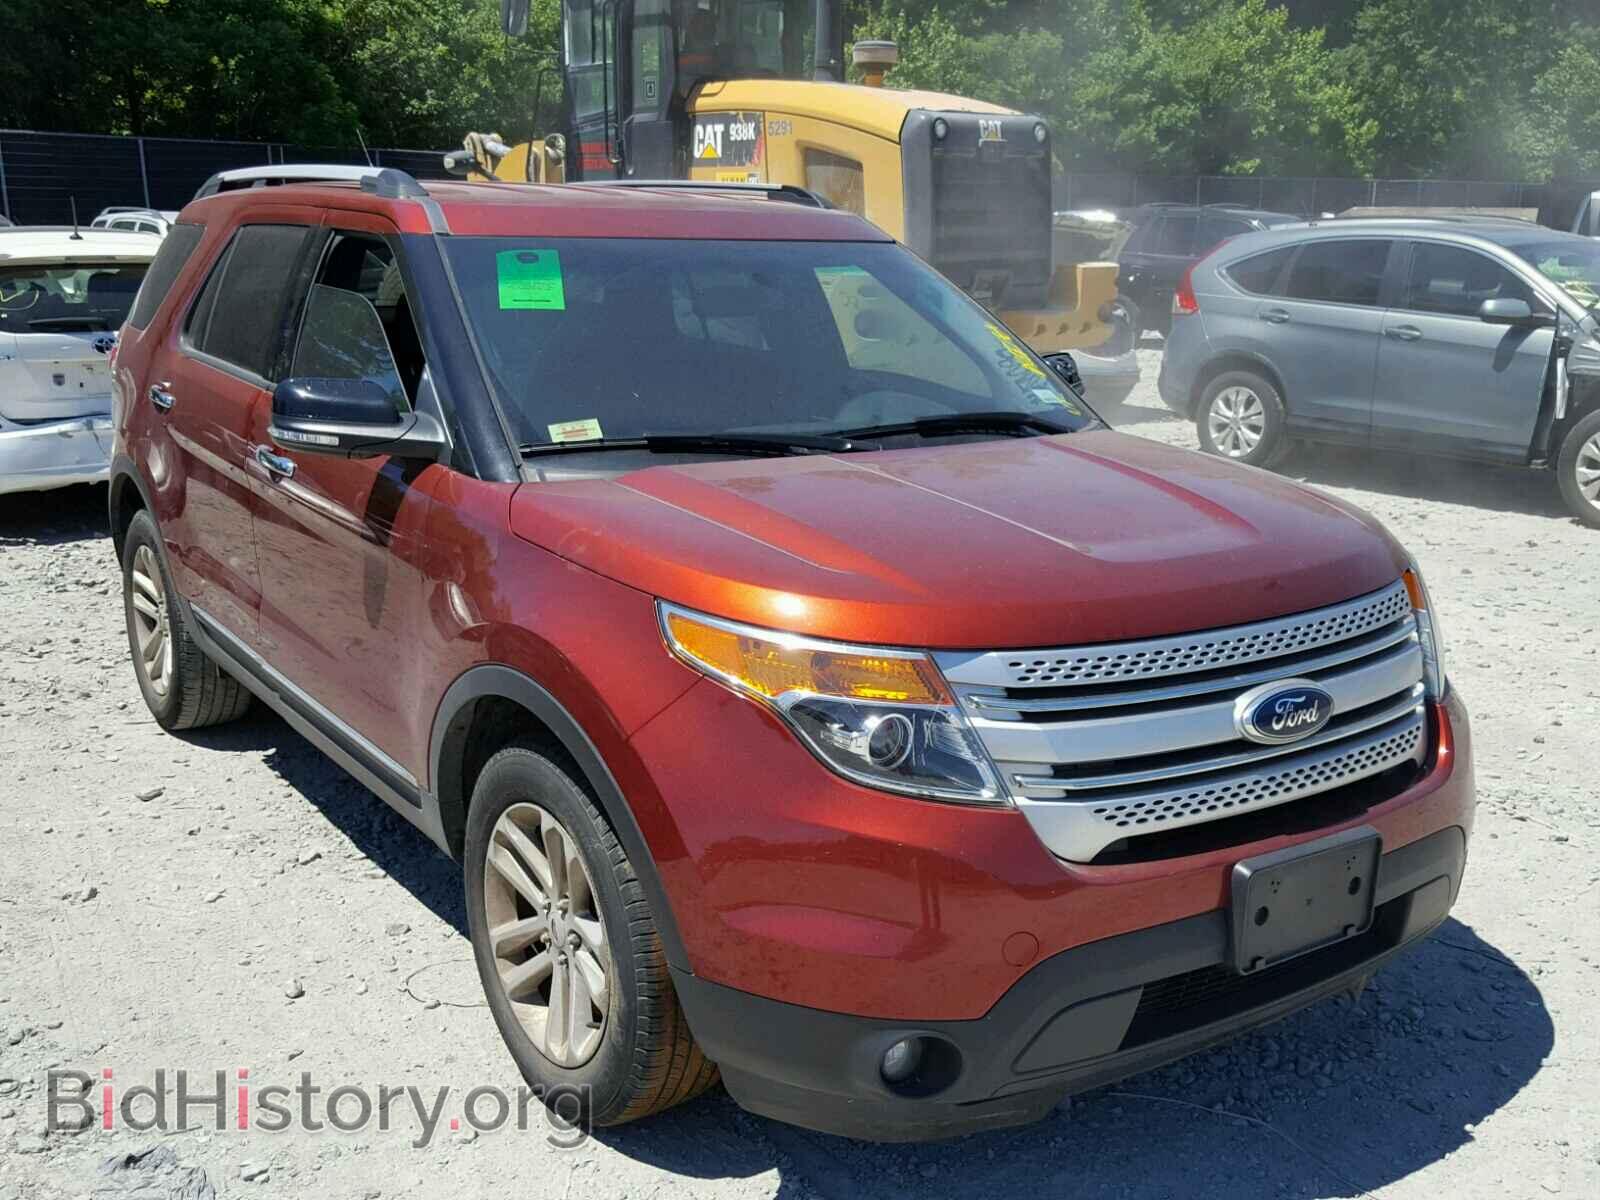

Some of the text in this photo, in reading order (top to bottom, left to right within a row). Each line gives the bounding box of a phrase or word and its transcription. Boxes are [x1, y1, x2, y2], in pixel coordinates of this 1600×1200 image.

[693, 124, 725, 159] CAT
[729, 122, 756, 140] 938K
[979, 119, 1002, 140] CAT
[1271, 695, 1320, 731] Ford
